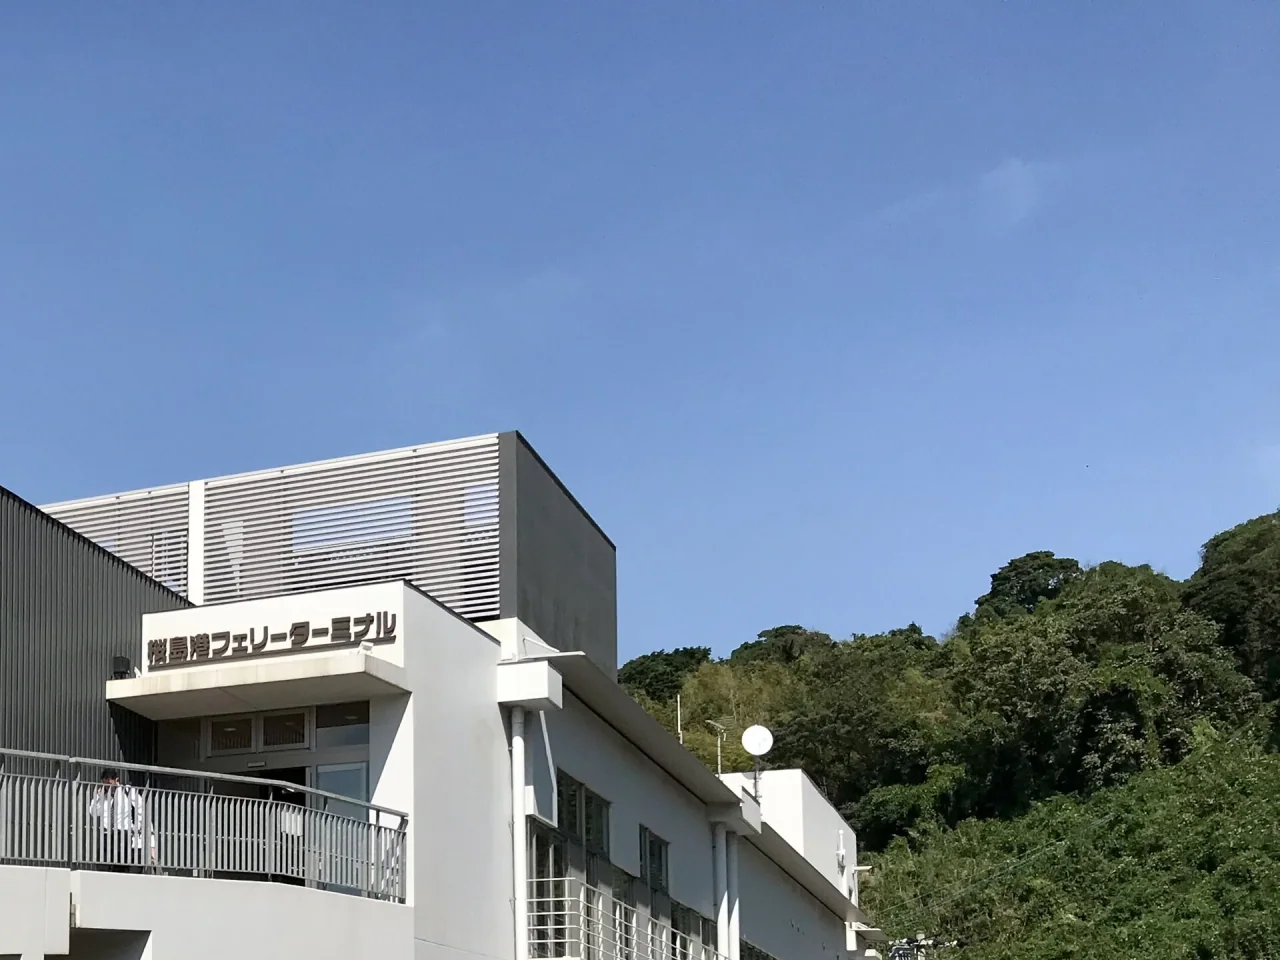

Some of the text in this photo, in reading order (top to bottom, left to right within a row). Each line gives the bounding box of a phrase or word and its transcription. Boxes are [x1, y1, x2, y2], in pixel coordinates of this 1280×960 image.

[147, 611, 397, 666] 桜島港フェリーターミナル
